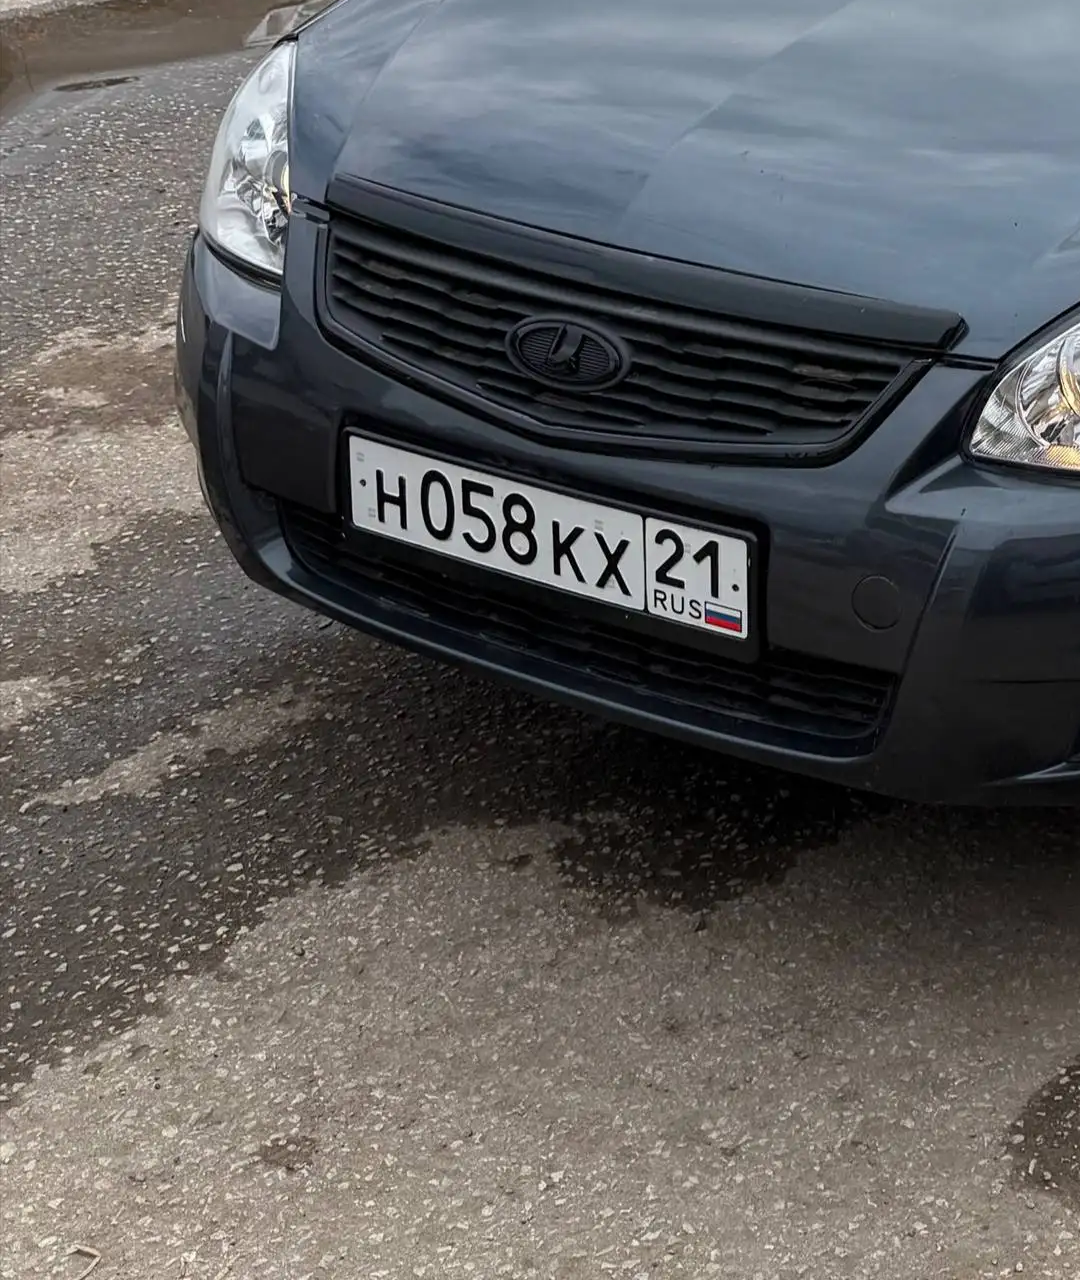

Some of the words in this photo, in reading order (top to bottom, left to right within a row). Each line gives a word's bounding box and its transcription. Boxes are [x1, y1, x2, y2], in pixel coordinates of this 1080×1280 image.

[375, 468, 632, 597] Н058КХ
[654, 528, 720, 598] 21
[654, 589, 703, 620] RUS
